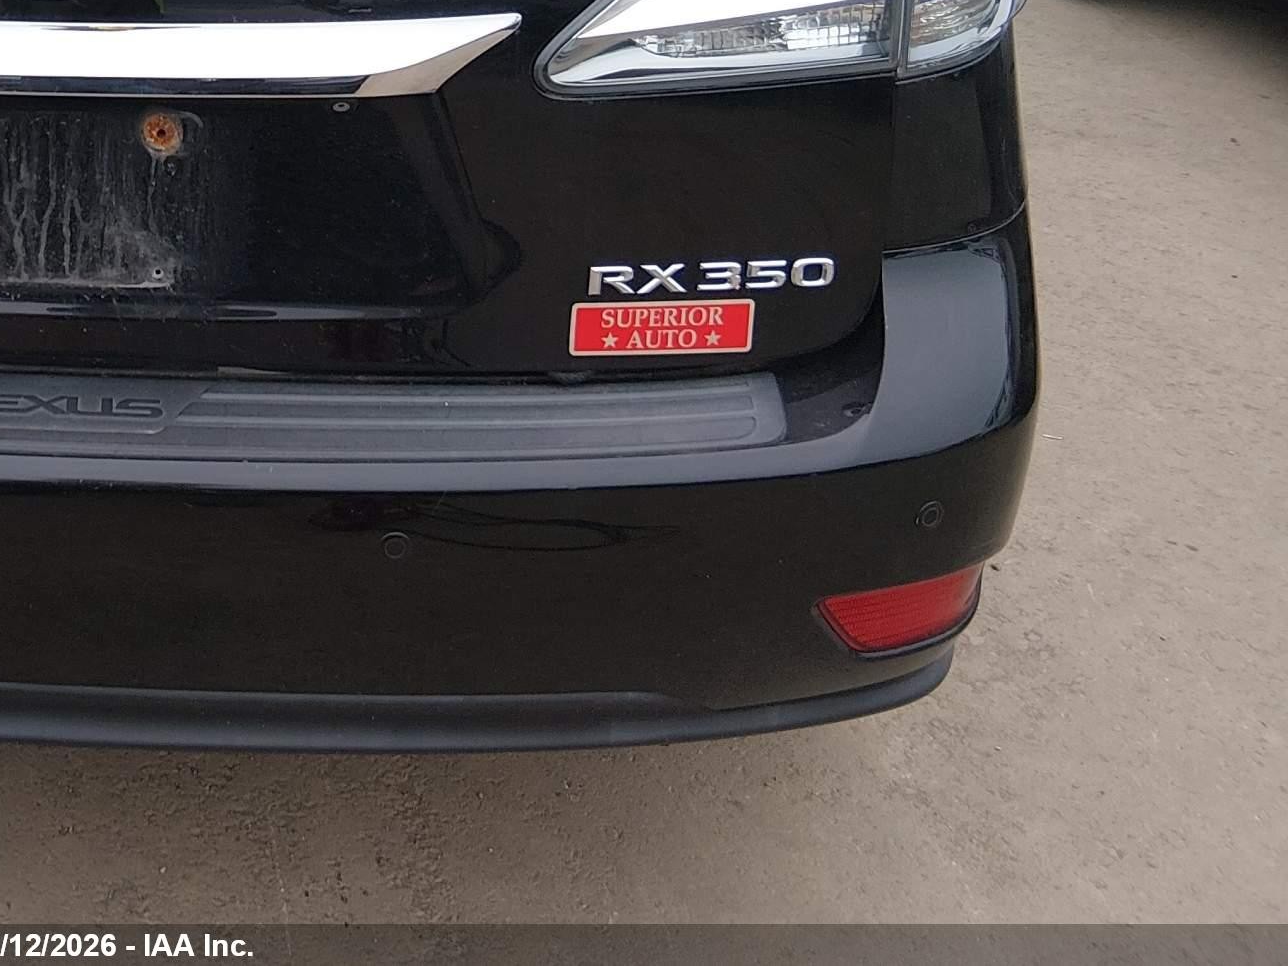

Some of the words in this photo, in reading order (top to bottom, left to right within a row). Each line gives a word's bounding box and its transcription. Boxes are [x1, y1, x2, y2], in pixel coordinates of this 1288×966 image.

[587, 263, 688, 296] RX
[697, 257, 835, 290] 350
[600, 306, 724, 328] SUPERIOR
[625, 330, 697, 349] AUTO
